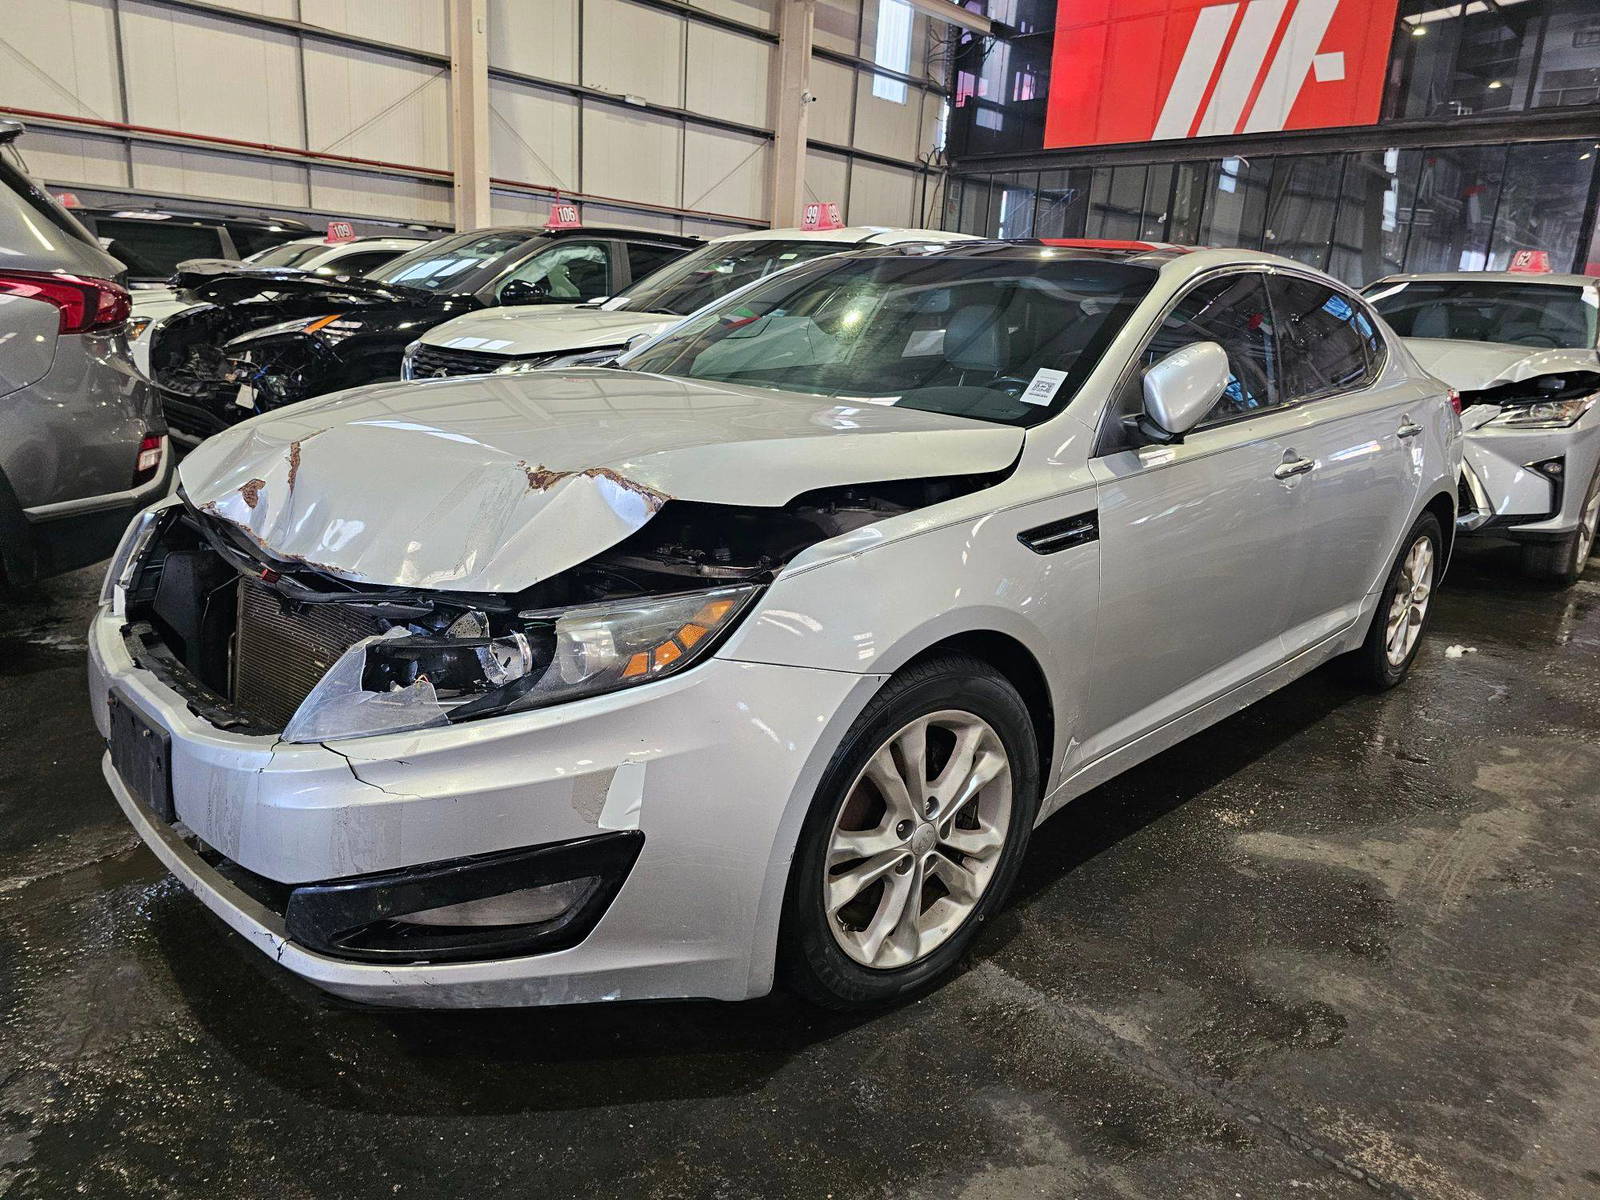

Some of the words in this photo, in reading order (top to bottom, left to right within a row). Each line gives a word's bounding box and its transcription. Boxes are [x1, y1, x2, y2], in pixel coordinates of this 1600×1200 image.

[558, 207, 576, 222] 106
[806, 205, 818, 224] 99
[1516, 251, 1531, 266] 62
